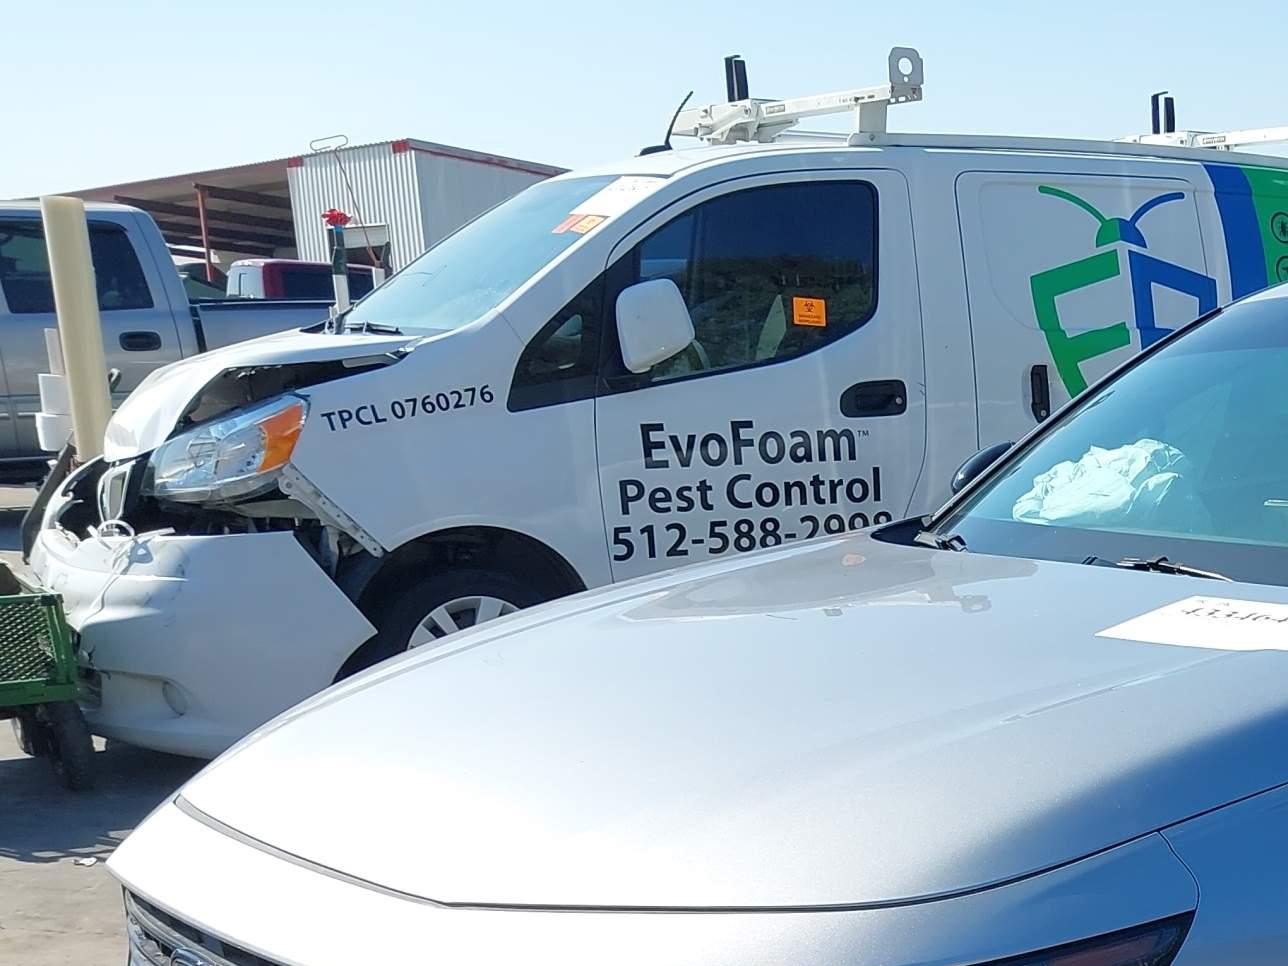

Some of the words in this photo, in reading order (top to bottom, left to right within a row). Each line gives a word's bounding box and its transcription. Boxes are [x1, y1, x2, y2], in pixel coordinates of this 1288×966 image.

[321, 404, 387, 431] TPCL
[390, 384, 494, 419] 0760276
[618, 478, 714, 515] Pest
[726, 466, 882, 509] Control
